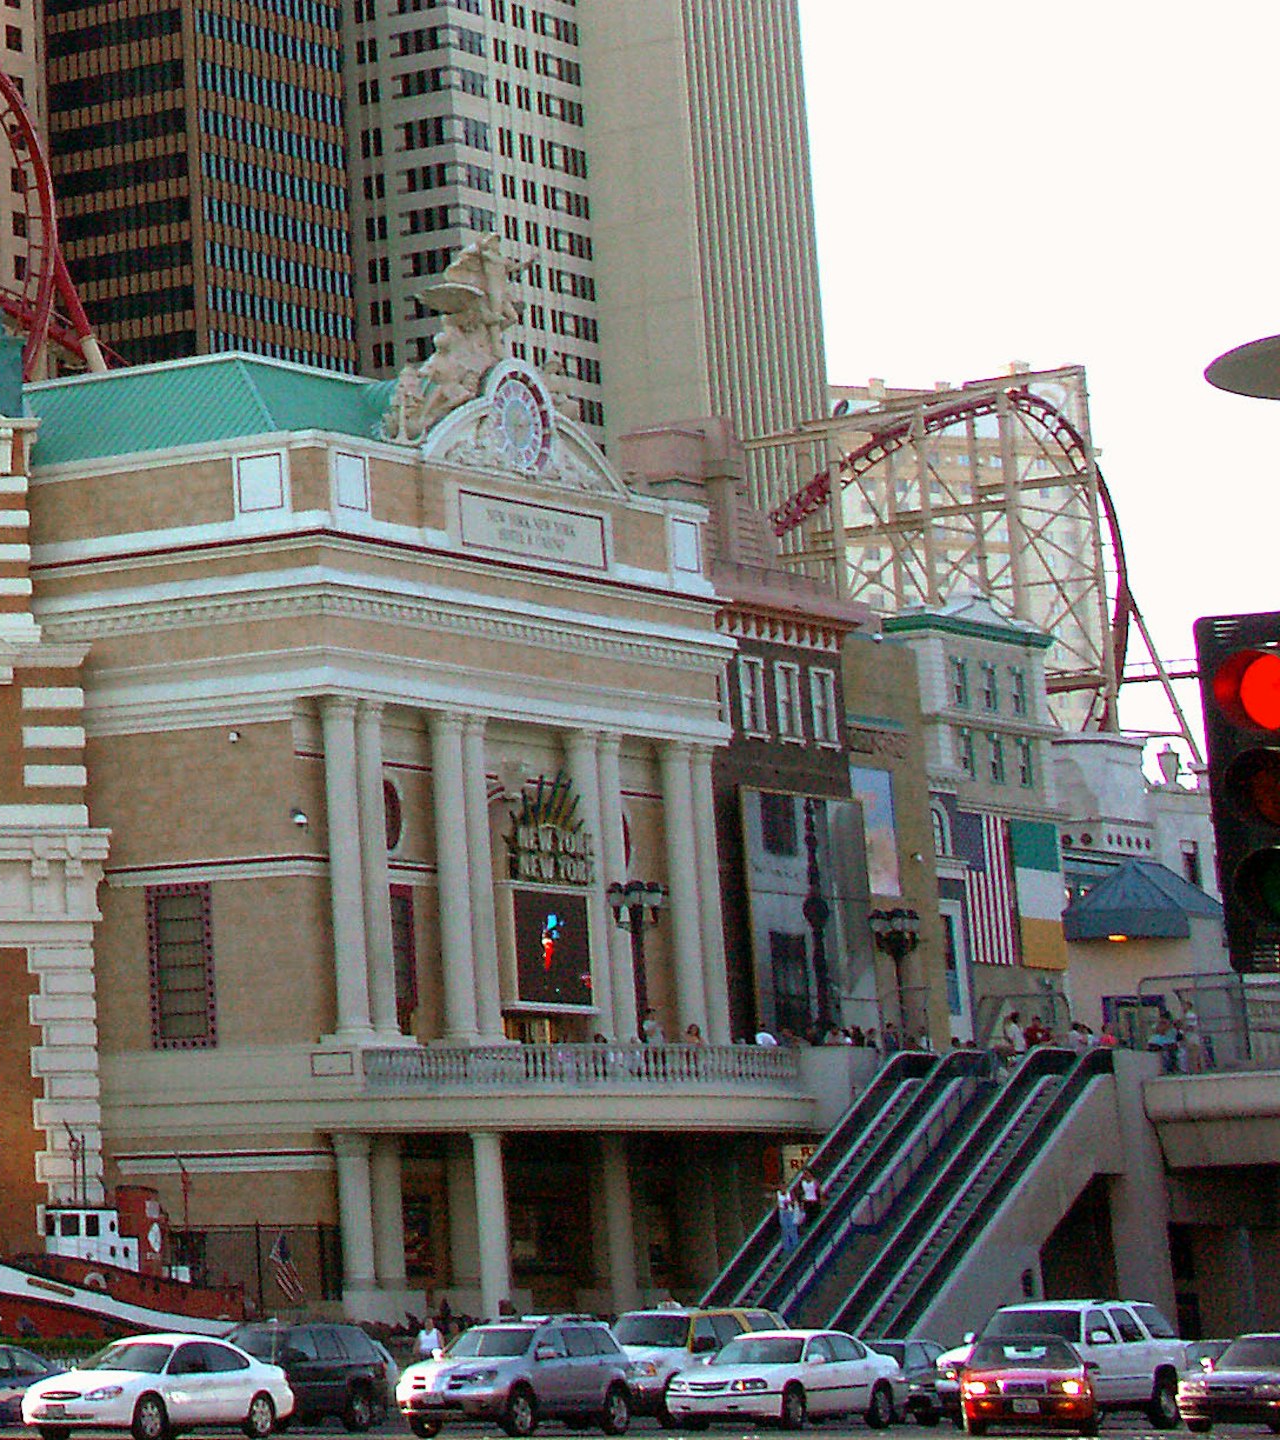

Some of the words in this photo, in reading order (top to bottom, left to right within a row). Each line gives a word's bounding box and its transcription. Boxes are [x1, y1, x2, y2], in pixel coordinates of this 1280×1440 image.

[519, 825, 554, 852] NEW
[555, 827, 594, 857] YORK
[520, 853, 555, 879] NEW
[557, 855, 595, 883] YORK
